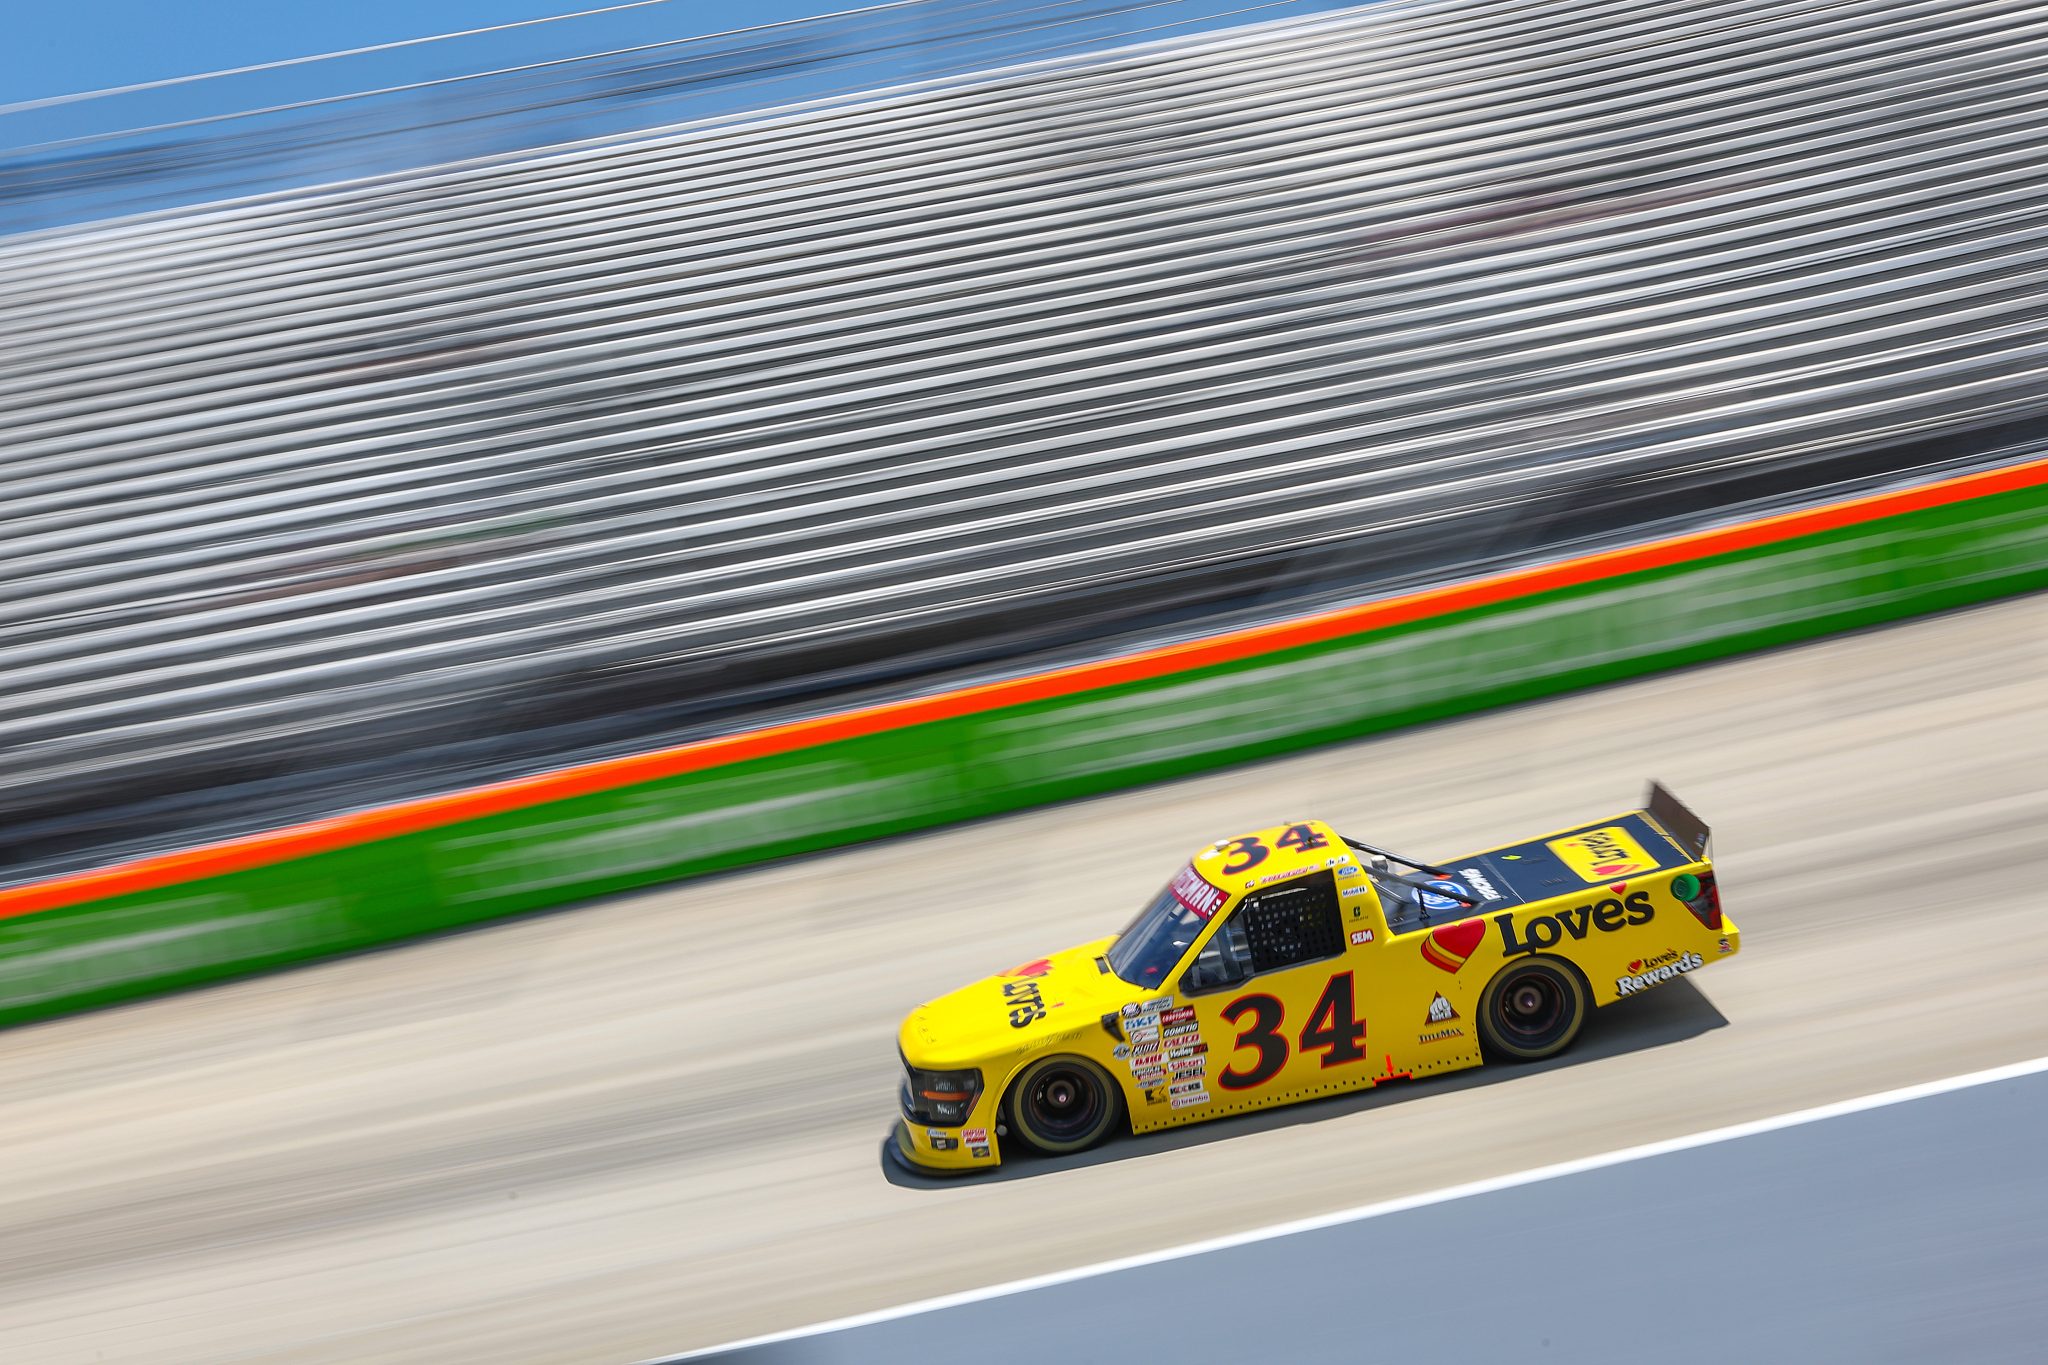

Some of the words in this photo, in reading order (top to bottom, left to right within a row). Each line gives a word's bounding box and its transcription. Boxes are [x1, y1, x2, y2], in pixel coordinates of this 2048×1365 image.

[1222, 824, 1330, 876] 34
[1351, 929, 1373, 945] SEM
[1615, 950, 1705, 998] Rewards
[1217, 969, 1367, 1092] 34
[1174, 1067, 1203, 1080] JESEL
[1181, 1094, 1209, 1106] brembo
